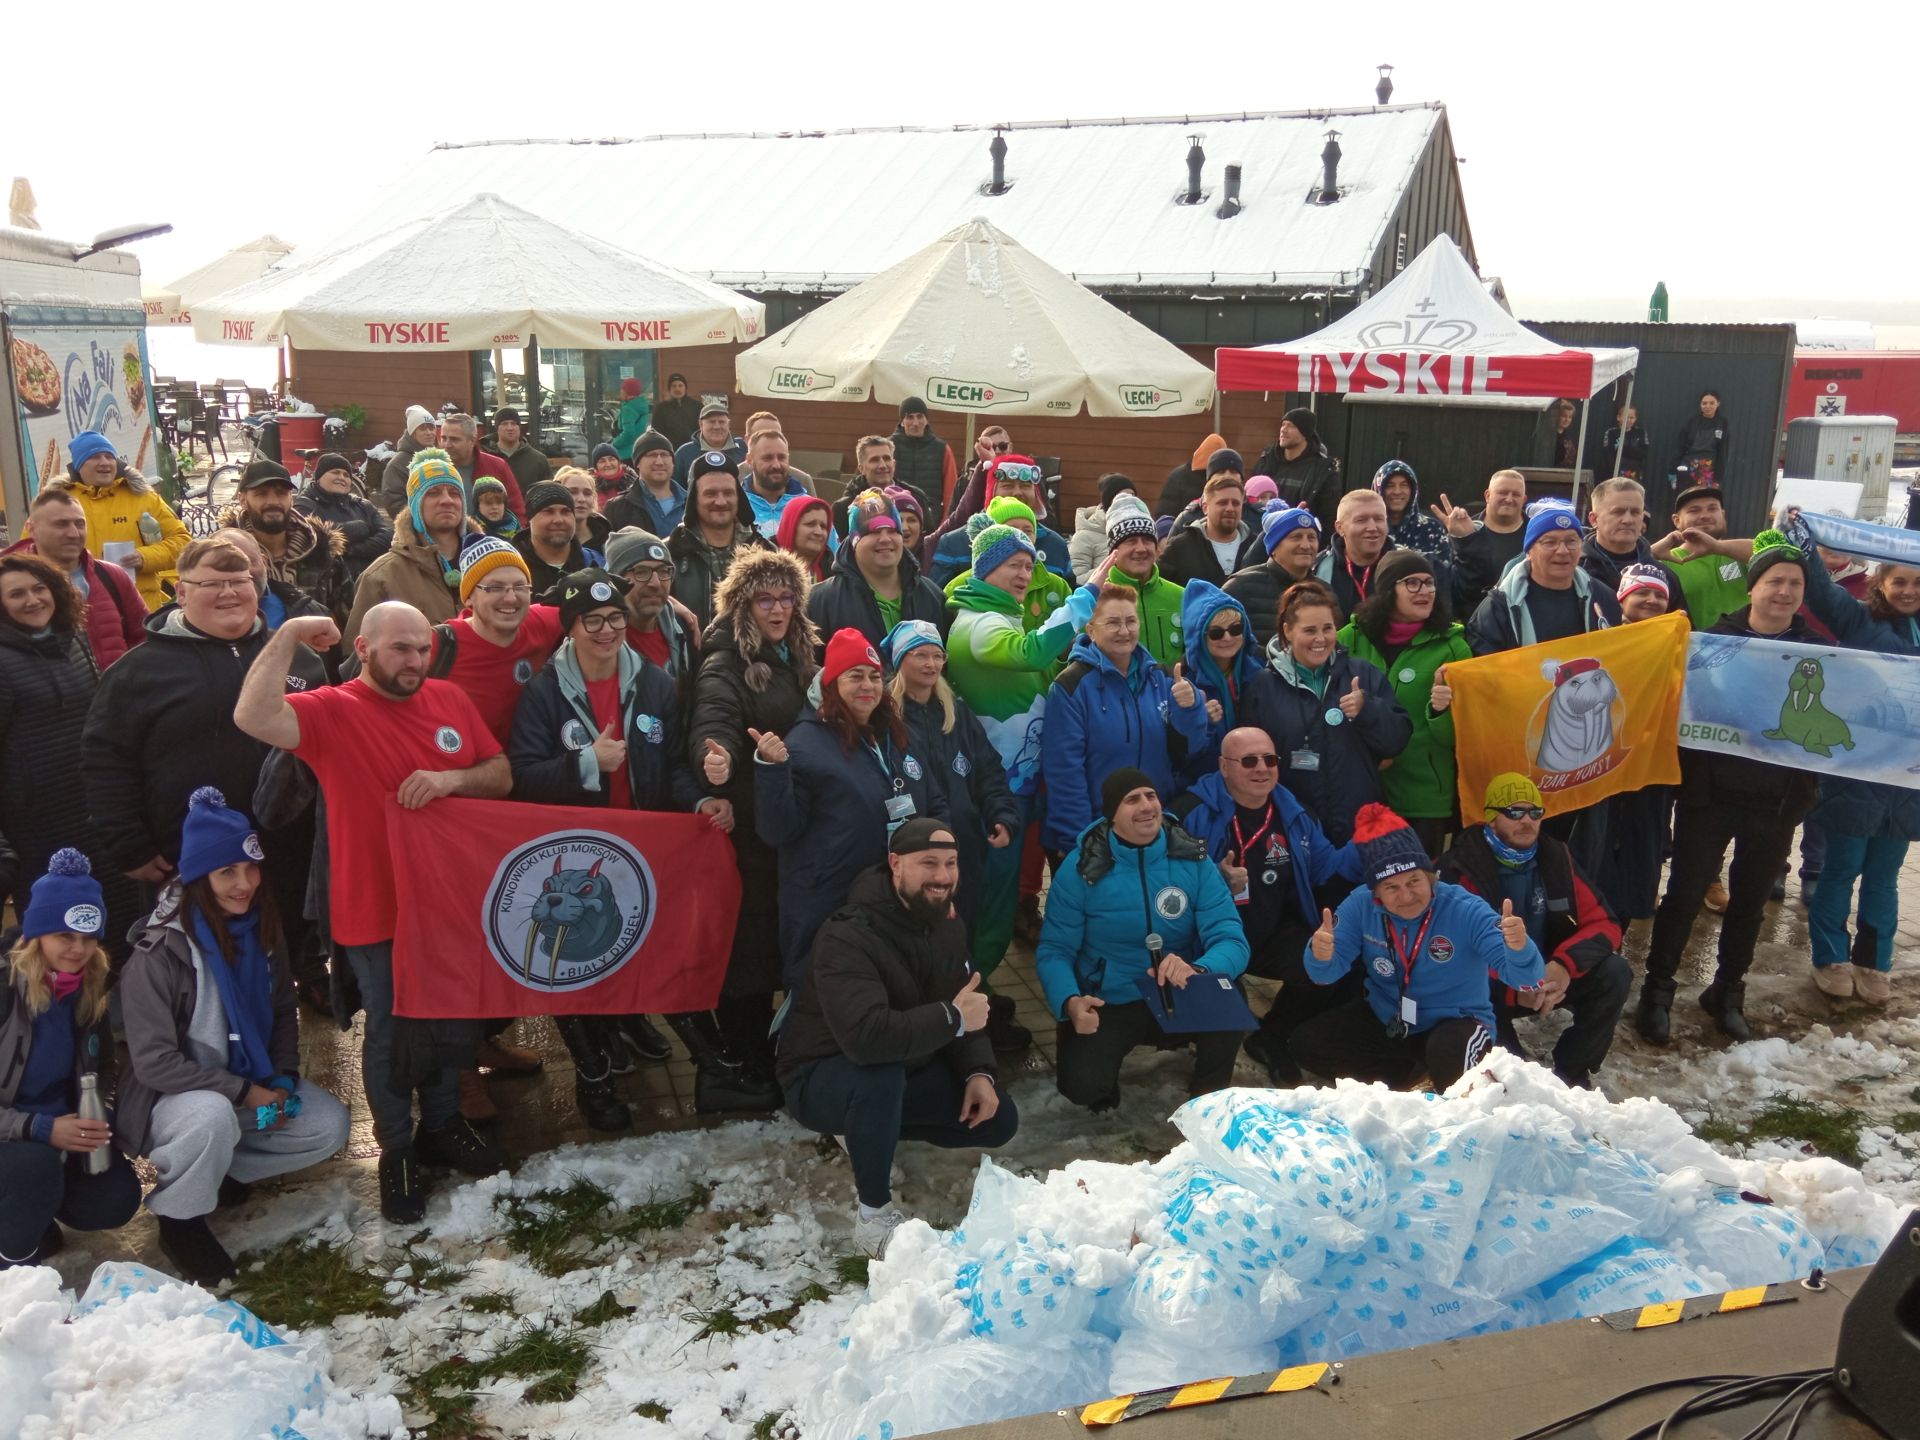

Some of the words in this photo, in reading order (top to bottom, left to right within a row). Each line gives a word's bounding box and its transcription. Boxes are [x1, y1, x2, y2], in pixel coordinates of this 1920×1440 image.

[143, 301, 164, 315] TYSKIE
[222, 320, 255, 341] TYSKIE
[364, 322, 450, 344] TYSKIE
[600, 320, 672, 341] TYSKIE
[776, 373, 807, 387] LECH
[1284, 350, 1507, 396] TYSKIE
[936, 384, 983, 401] LECH
[1125, 391, 1153, 405] LECH
[1679, 723, 1742, 746] DĘBICA
[500, 857, 540, 913] KUNOWICKI
[538, 845, 569, 860] KLUB
[1376, 869, 1397, 880] SHARK
[1397, 861, 1416, 872] TEAM
[568, 955, 608, 977] BIAŁY
[609, 911, 641, 958] DIABEŁ
[1462, 1136, 1478, 1162] 10kg
[1567, 1205, 1595, 1221] 10kg
[1429, 1299, 1462, 1317] 10kg
